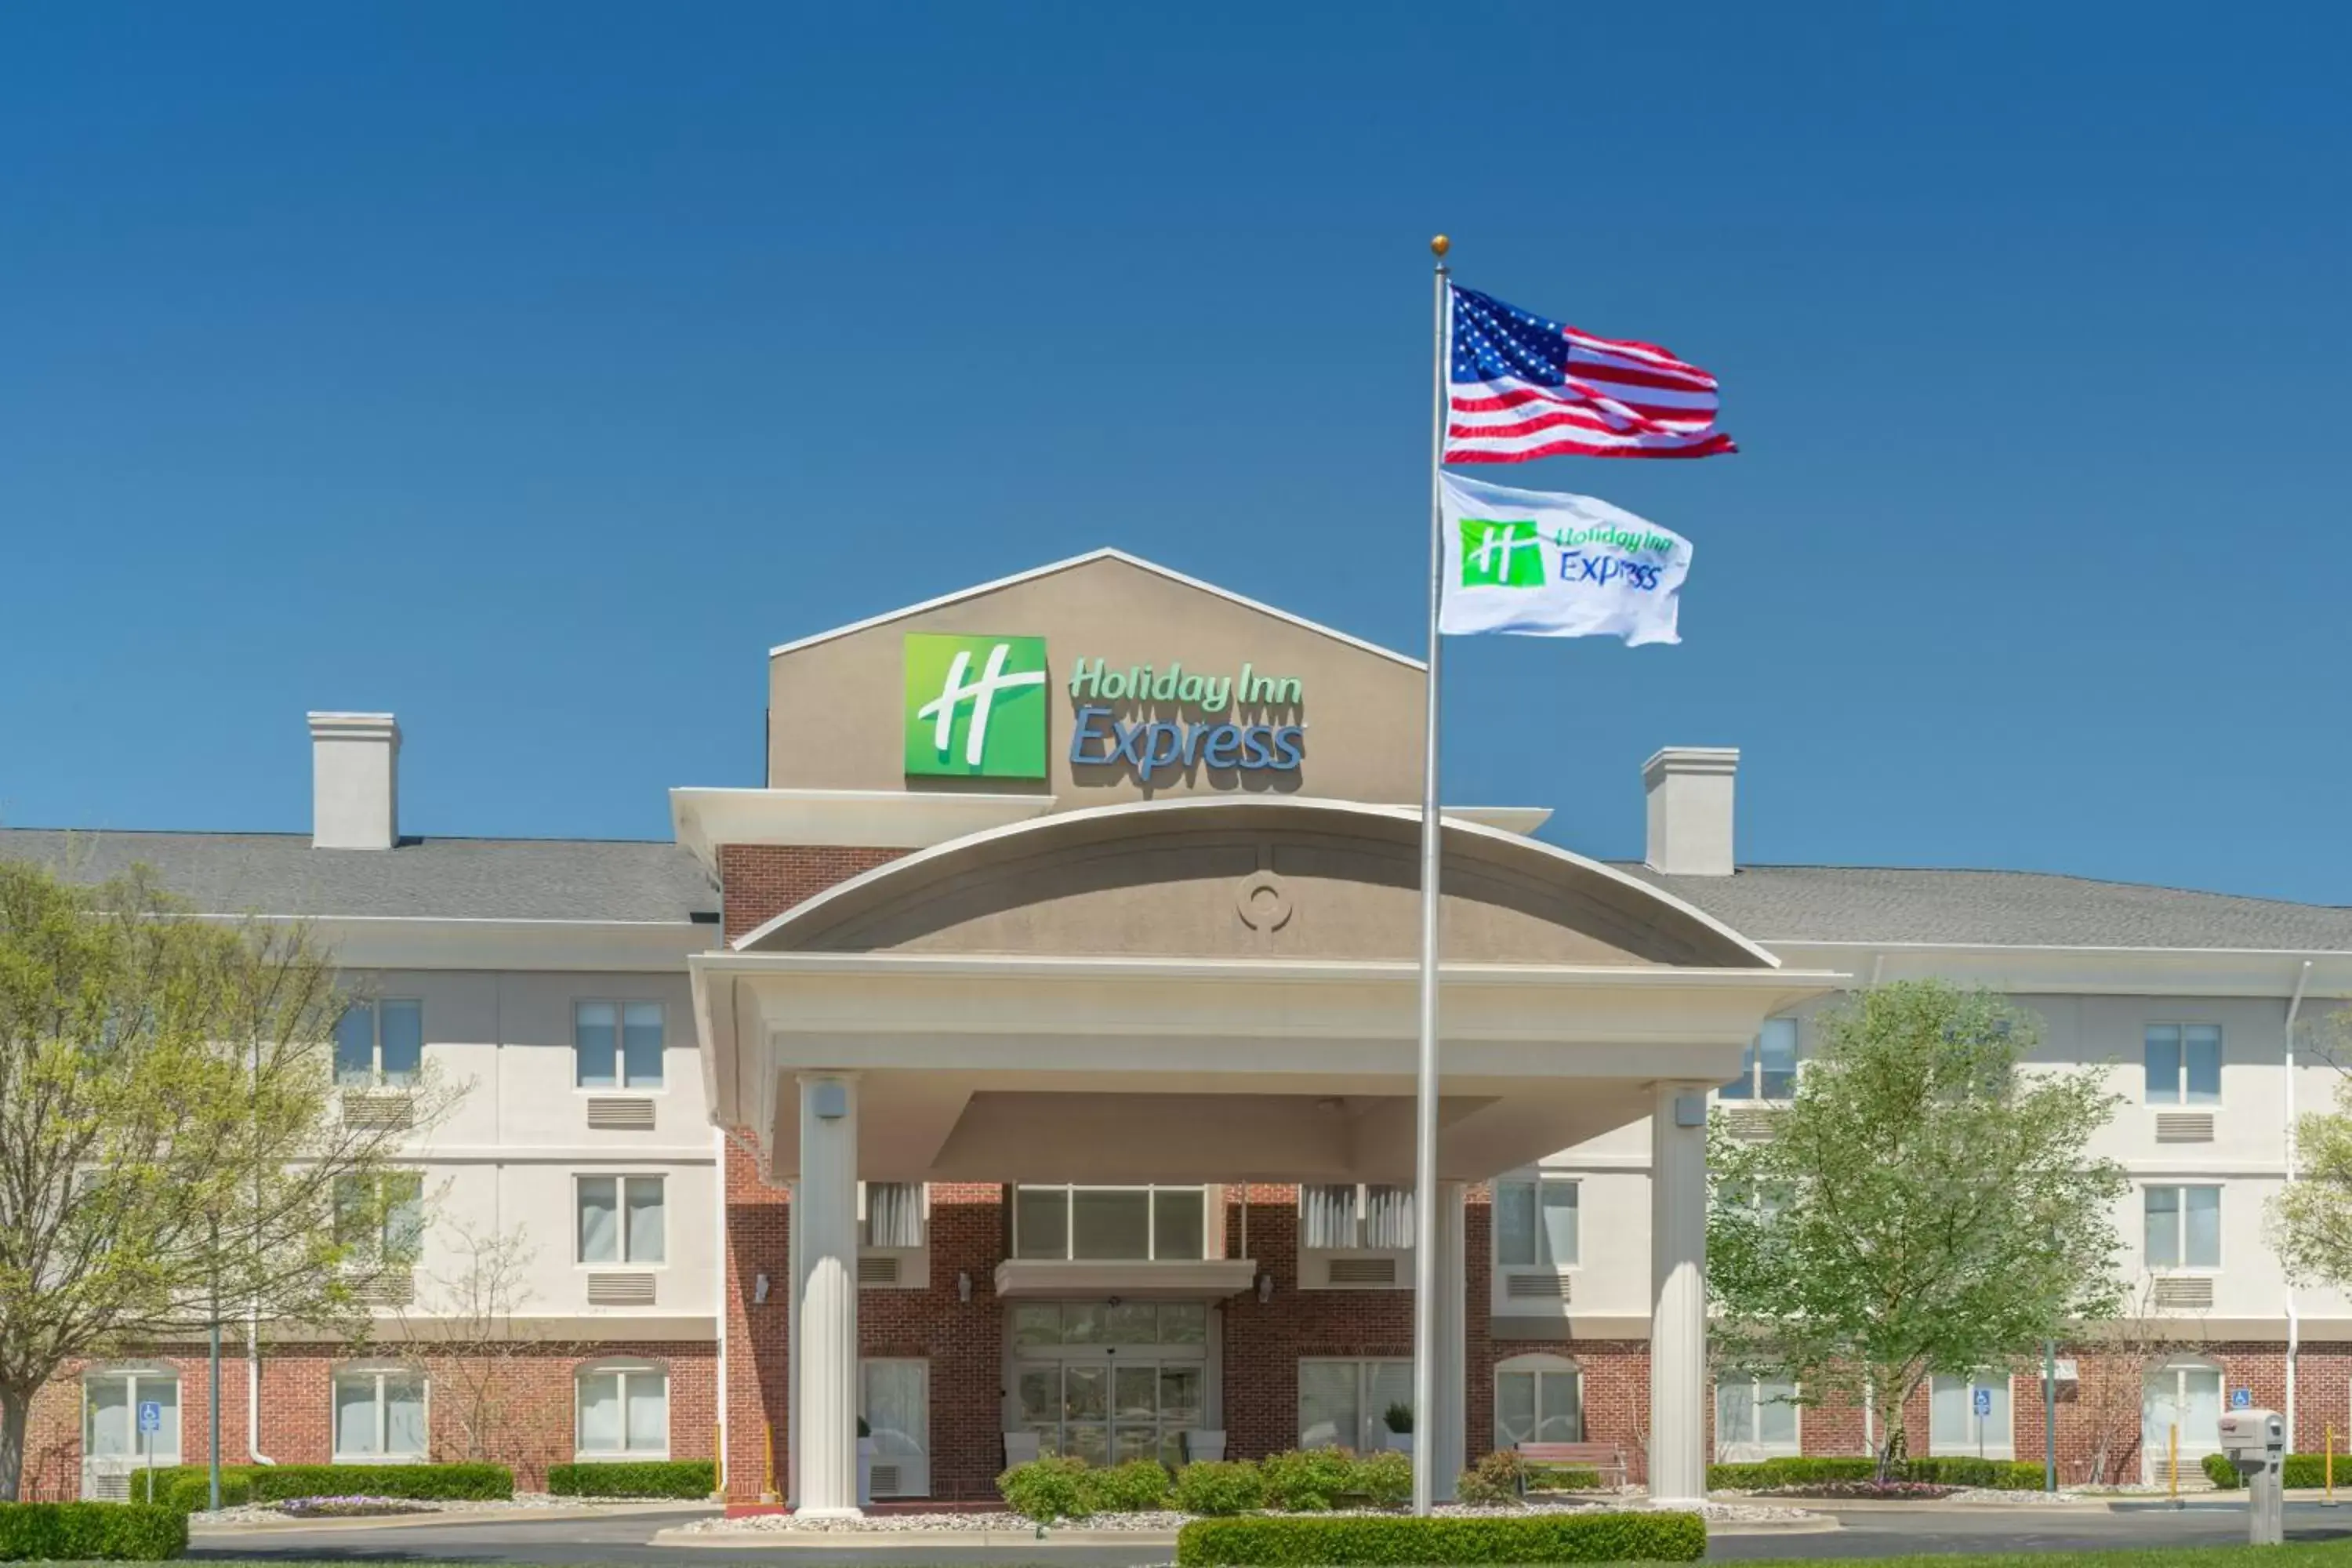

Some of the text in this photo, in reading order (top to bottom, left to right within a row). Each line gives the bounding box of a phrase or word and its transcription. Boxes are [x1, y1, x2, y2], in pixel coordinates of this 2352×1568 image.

[1555, 526, 1672, 552] Holiday Inn
[918, 644, 1045, 765] H
[1069, 658, 1302, 711] Holiday Inn
[1069, 706, 1303, 780] Express
